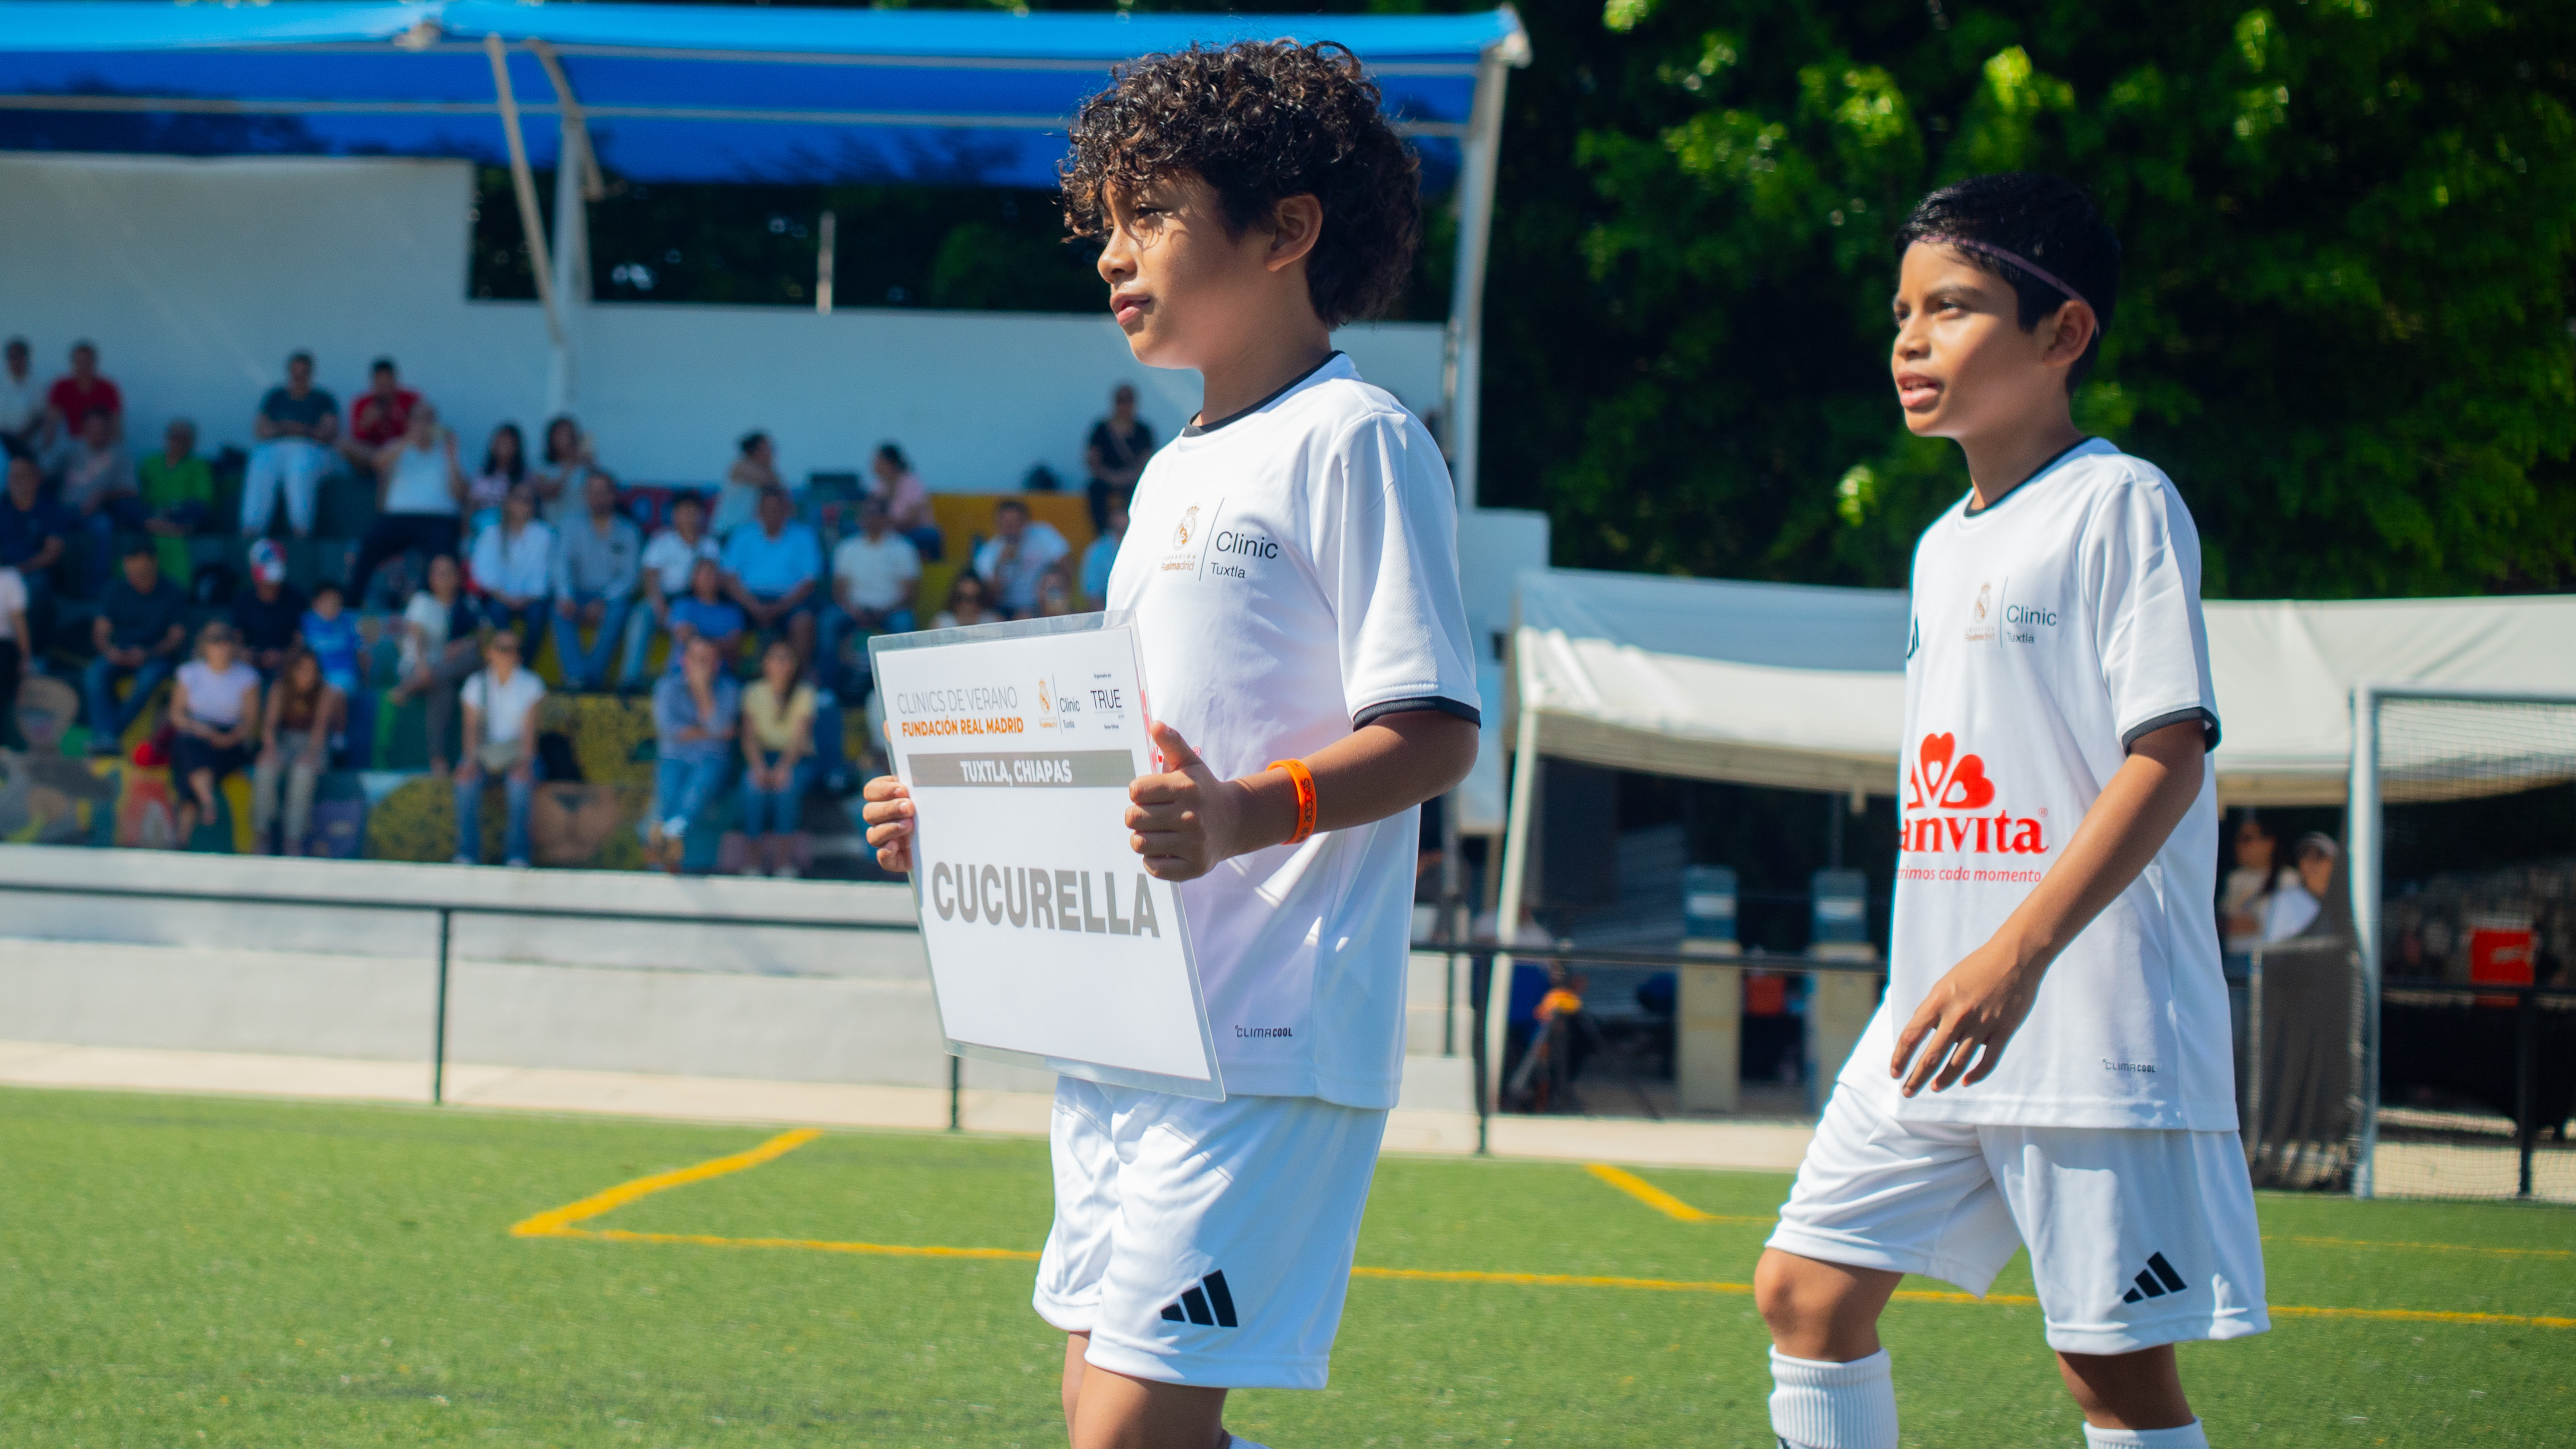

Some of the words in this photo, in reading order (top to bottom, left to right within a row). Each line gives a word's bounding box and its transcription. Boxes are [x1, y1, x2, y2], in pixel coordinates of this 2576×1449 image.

[1216, 531, 1278, 559] Clinic
[1211, 562, 1246, 579] Tuxtla
[2006, 605, 2056, 626] Clinic
[2007, 632, 2035, 644] Tuxtla
[897, 690, 946, 714] CLINICS
[947, 689, 966, 711] DE
[965, 686, 1018, 710] VERANO
[1060, 697, 1080, 713] Clinic
[1090, 689, 1122, 709] TRUE
[902, 715, 958, 737] FUNDACIÓN
[960, 718, 984, 735] REAL
[986, 716, 1023, 734] MADRID
[1062, 719, 1075, 729] Tuxtla
[959, 760, 1013, 787] TUXTLA,
[1013, 759, 1072, 783] CHIAPAS
[1939, 866, 1970, 881] cada
[1973, 868, 2041, 882] momento
[932, 861, 1161, 939] CUCURELLA
[1236, 1028, 1293, 1038] CLIMACOOL
[2105, 1062, 2156, 1073] CLIMACOOL
